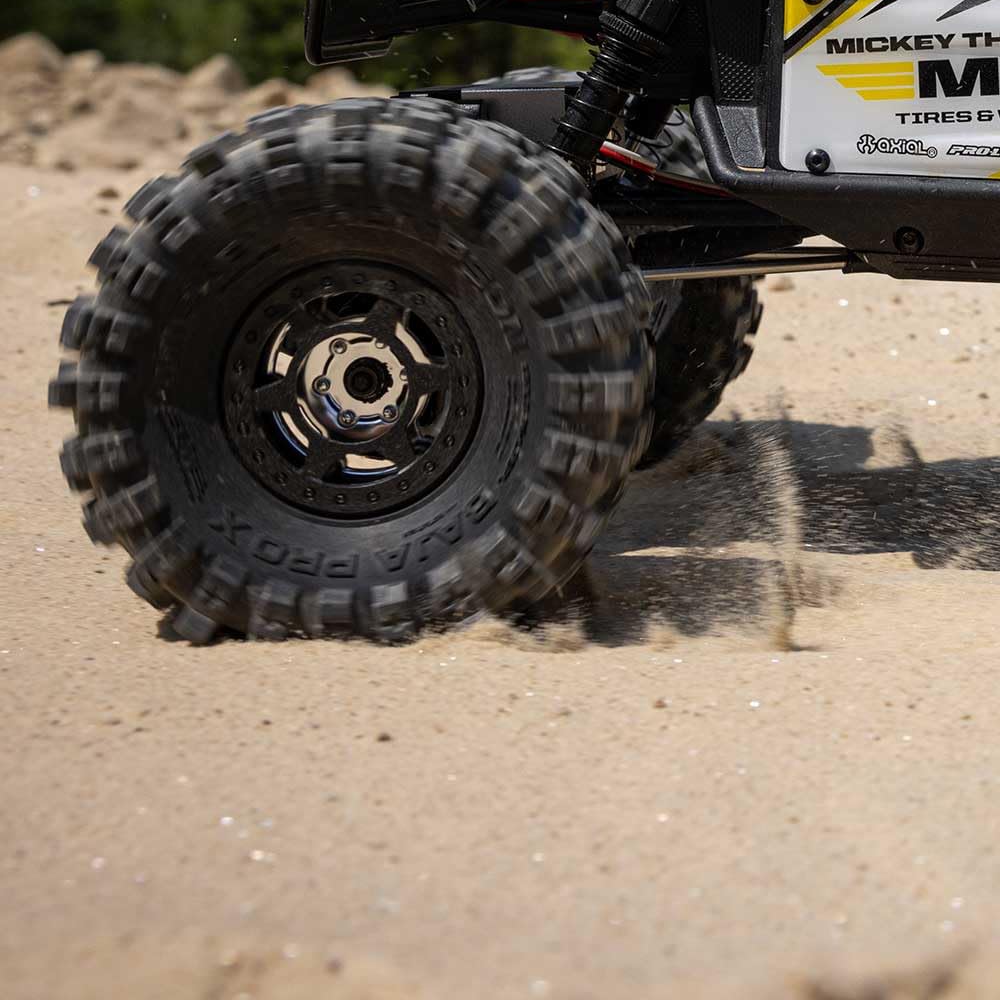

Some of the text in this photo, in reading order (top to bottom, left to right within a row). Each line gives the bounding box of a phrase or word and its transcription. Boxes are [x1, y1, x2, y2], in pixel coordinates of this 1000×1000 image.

[826, 33, 956, 55] MICKEY
[895, 110, 973, 125] TIRES
[977, 110, 994, 122] &
